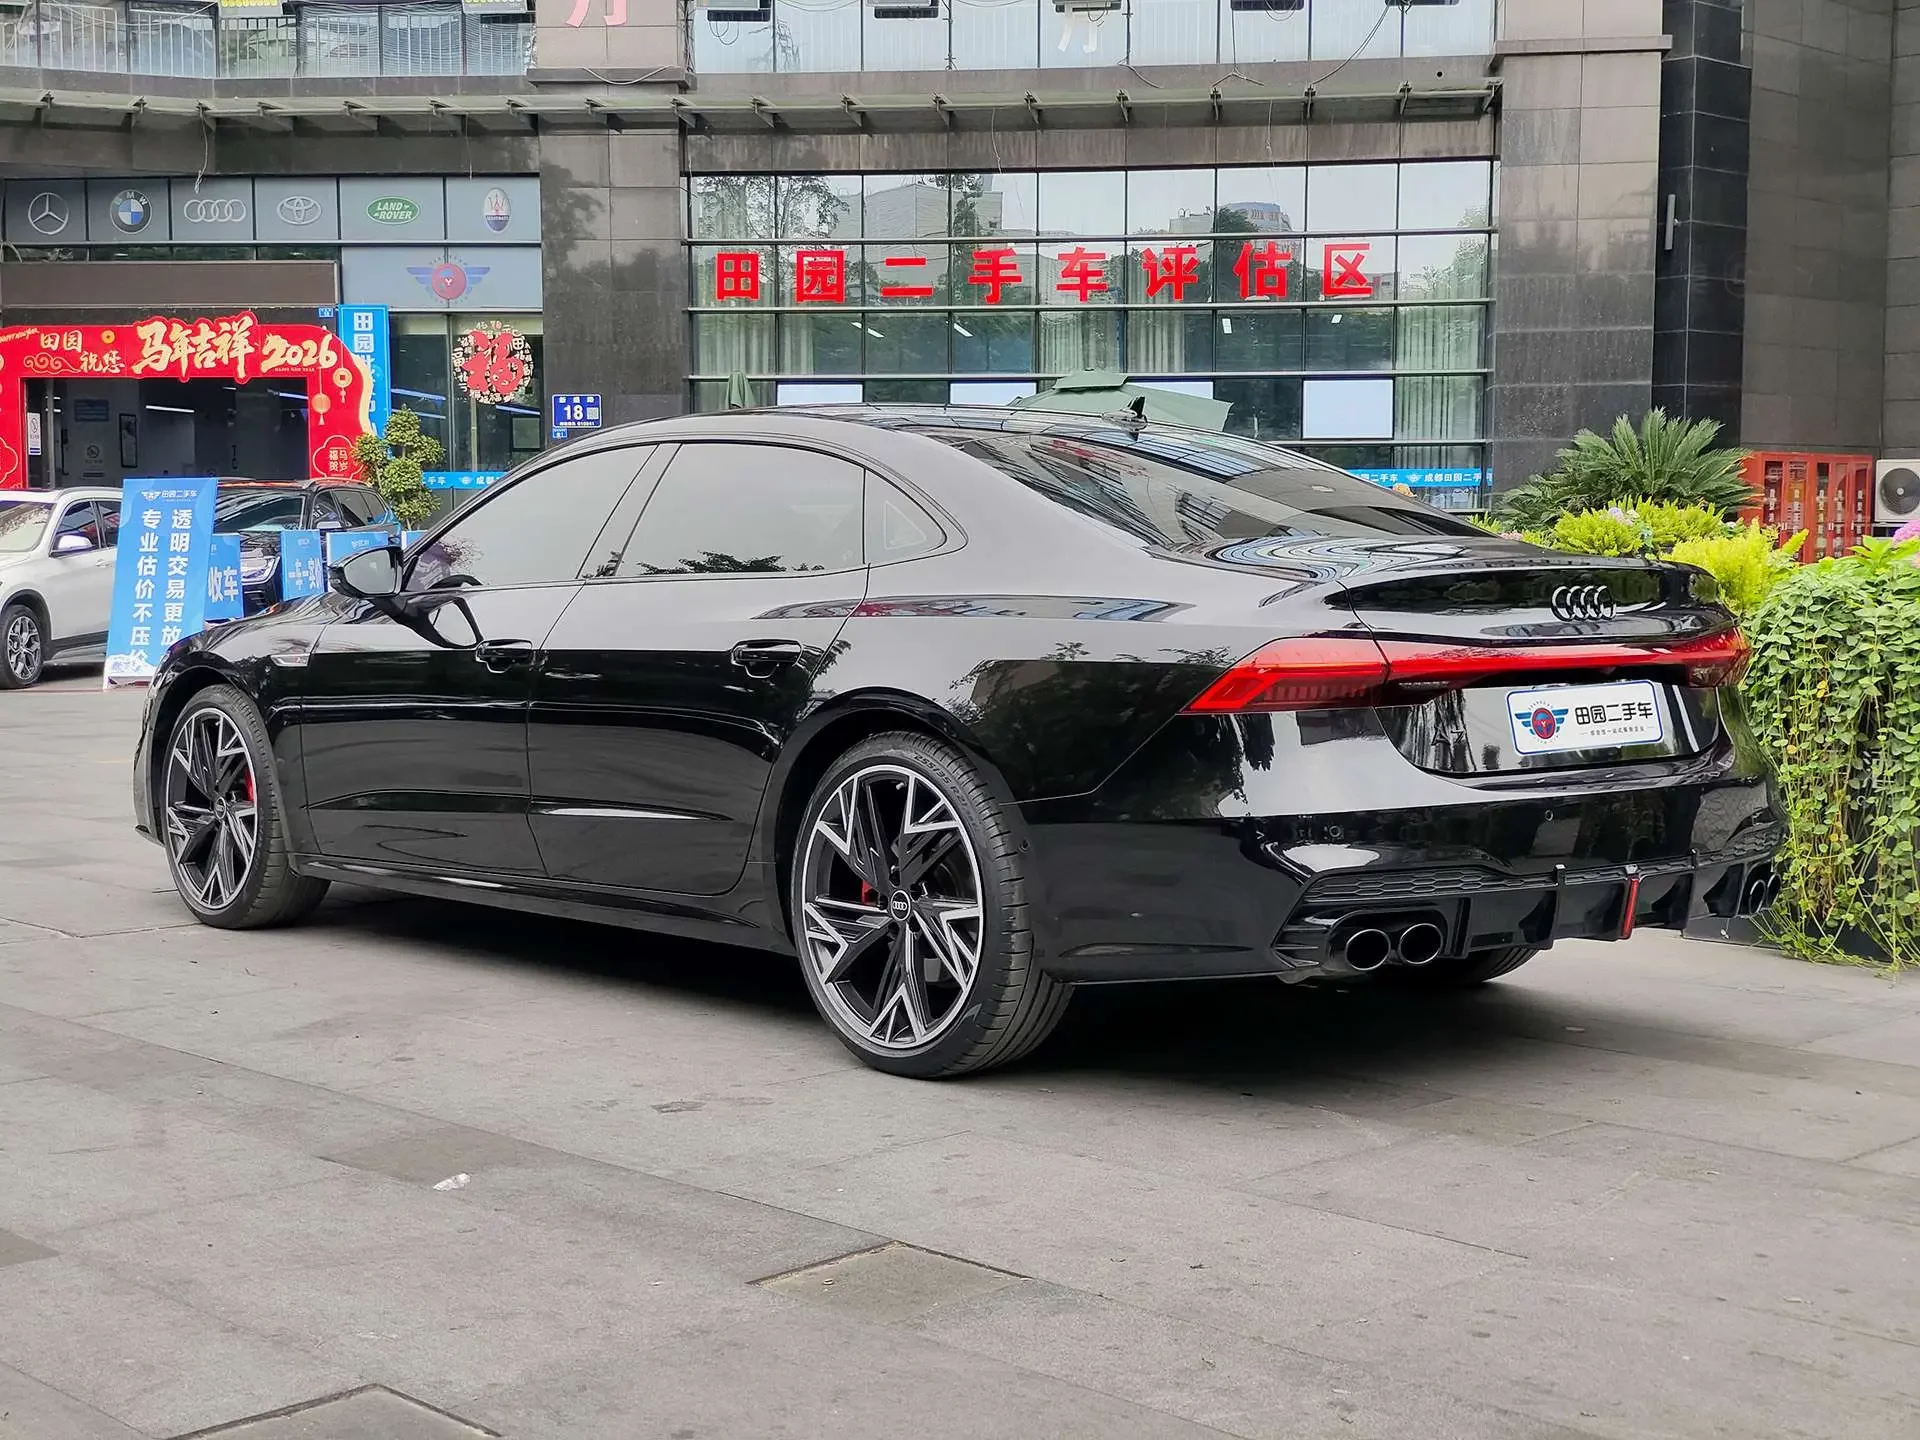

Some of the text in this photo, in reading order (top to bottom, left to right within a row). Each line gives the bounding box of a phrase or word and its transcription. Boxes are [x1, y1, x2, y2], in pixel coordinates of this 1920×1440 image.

[114, 191, 148, 205] BMW
[376, 202, 404, 211] LAND
[378, 210, 413, 220] ROVER
[715, 241, 1373, 305] 田园二手车评估区
[40, 330, 83, 352] 田园
[131, 316, 255, 379] 马年吉祥
[79, 350, 126, 374] 祝您
[260, 333, 338, 373] 2026
[461, 330, 524, 395] 福
[564, 404, 584, 420] 18
[475, 475, 500, 485] 成都
[1356, 473, 1399, 483] 园二手车
[160, 508, 193, 661] 透明交易更放
[1574, 702, 1654, 725] 田园二手车
[914, 752, 952, 784] 255/35
